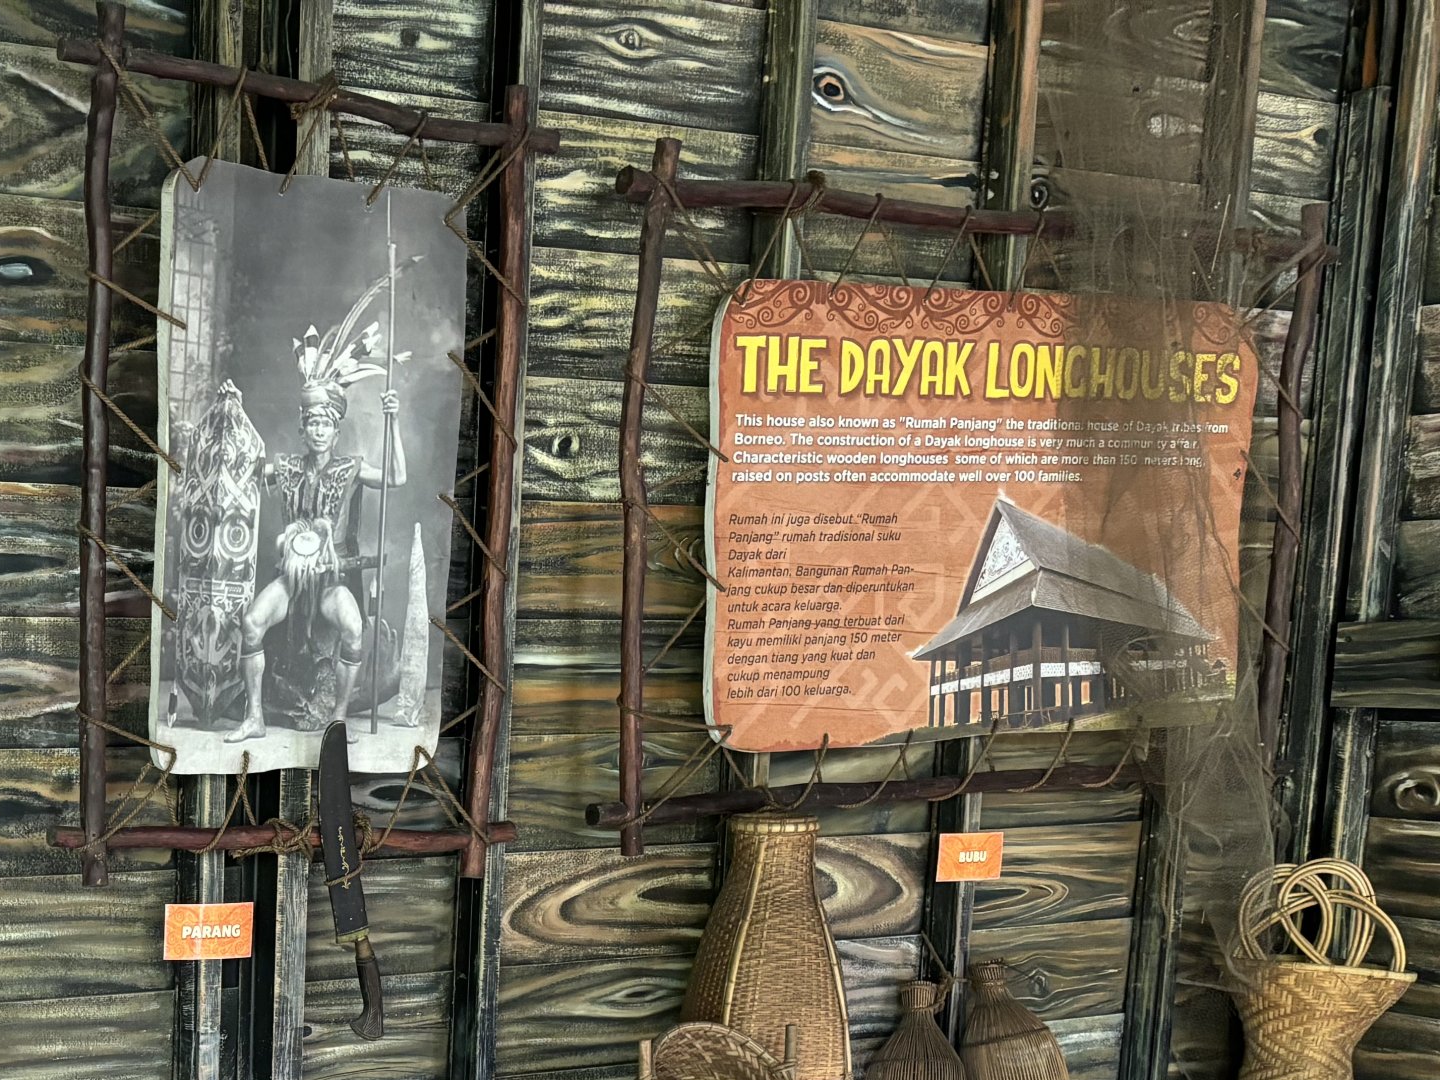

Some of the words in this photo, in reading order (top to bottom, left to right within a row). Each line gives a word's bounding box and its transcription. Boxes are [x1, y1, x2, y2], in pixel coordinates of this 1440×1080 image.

[735, 336, 827, 393] THE
[840, 339, 973, 397] DAYAK
[735, 413, 763, 427] This
[767, 414, 805, 427] house
[806, 414, 834, 427] also
[836, 414, 879, 428] known
[882, 418, 896, 428] as
[1003, 418, 1024, 430] the
[732, 469, 772, 482] raised
[776, 471, 792, 482] on
[796, 470, 830, 484] posts
[834, 470, 866, 482] often
[870, 470, 955, 482] accommodate
[959, 470, 982, 482] well
[985, 472, 1011, 482] over
[1014, 469, 1036, 483] 100
[1036, 470, 1082, 483] families.
[729, 513, 767, 525] Rumah
[771, 514, 784, 525] ini
[786, 514, 810, 528] juga
[813, 512, 853, 524] disebut
[782, 530, 815, 542] rumah
[819, 529, 875, 542] tradisional
[877, 530, 901, 542] suku
[728, 548, 762, 563] Dayak
[765, 548, 787, 560] dari
[727, 636, 752, 649] kayu
[755, 633, 802, 647] memiliki
[804, 634, 846, 647] panjang
[851, 629, 868, 644] 150
[871, 628, 902, 643] meter
[727, 687, 753, 699] lebih
[757, 685, 778, 698] dari
[782, 684, 800, 697] 100
[804, 684, 851, 697] keluarga.
[958, 850, 987, 863] BUBU
[181, 924, 241, 939] PARANG
